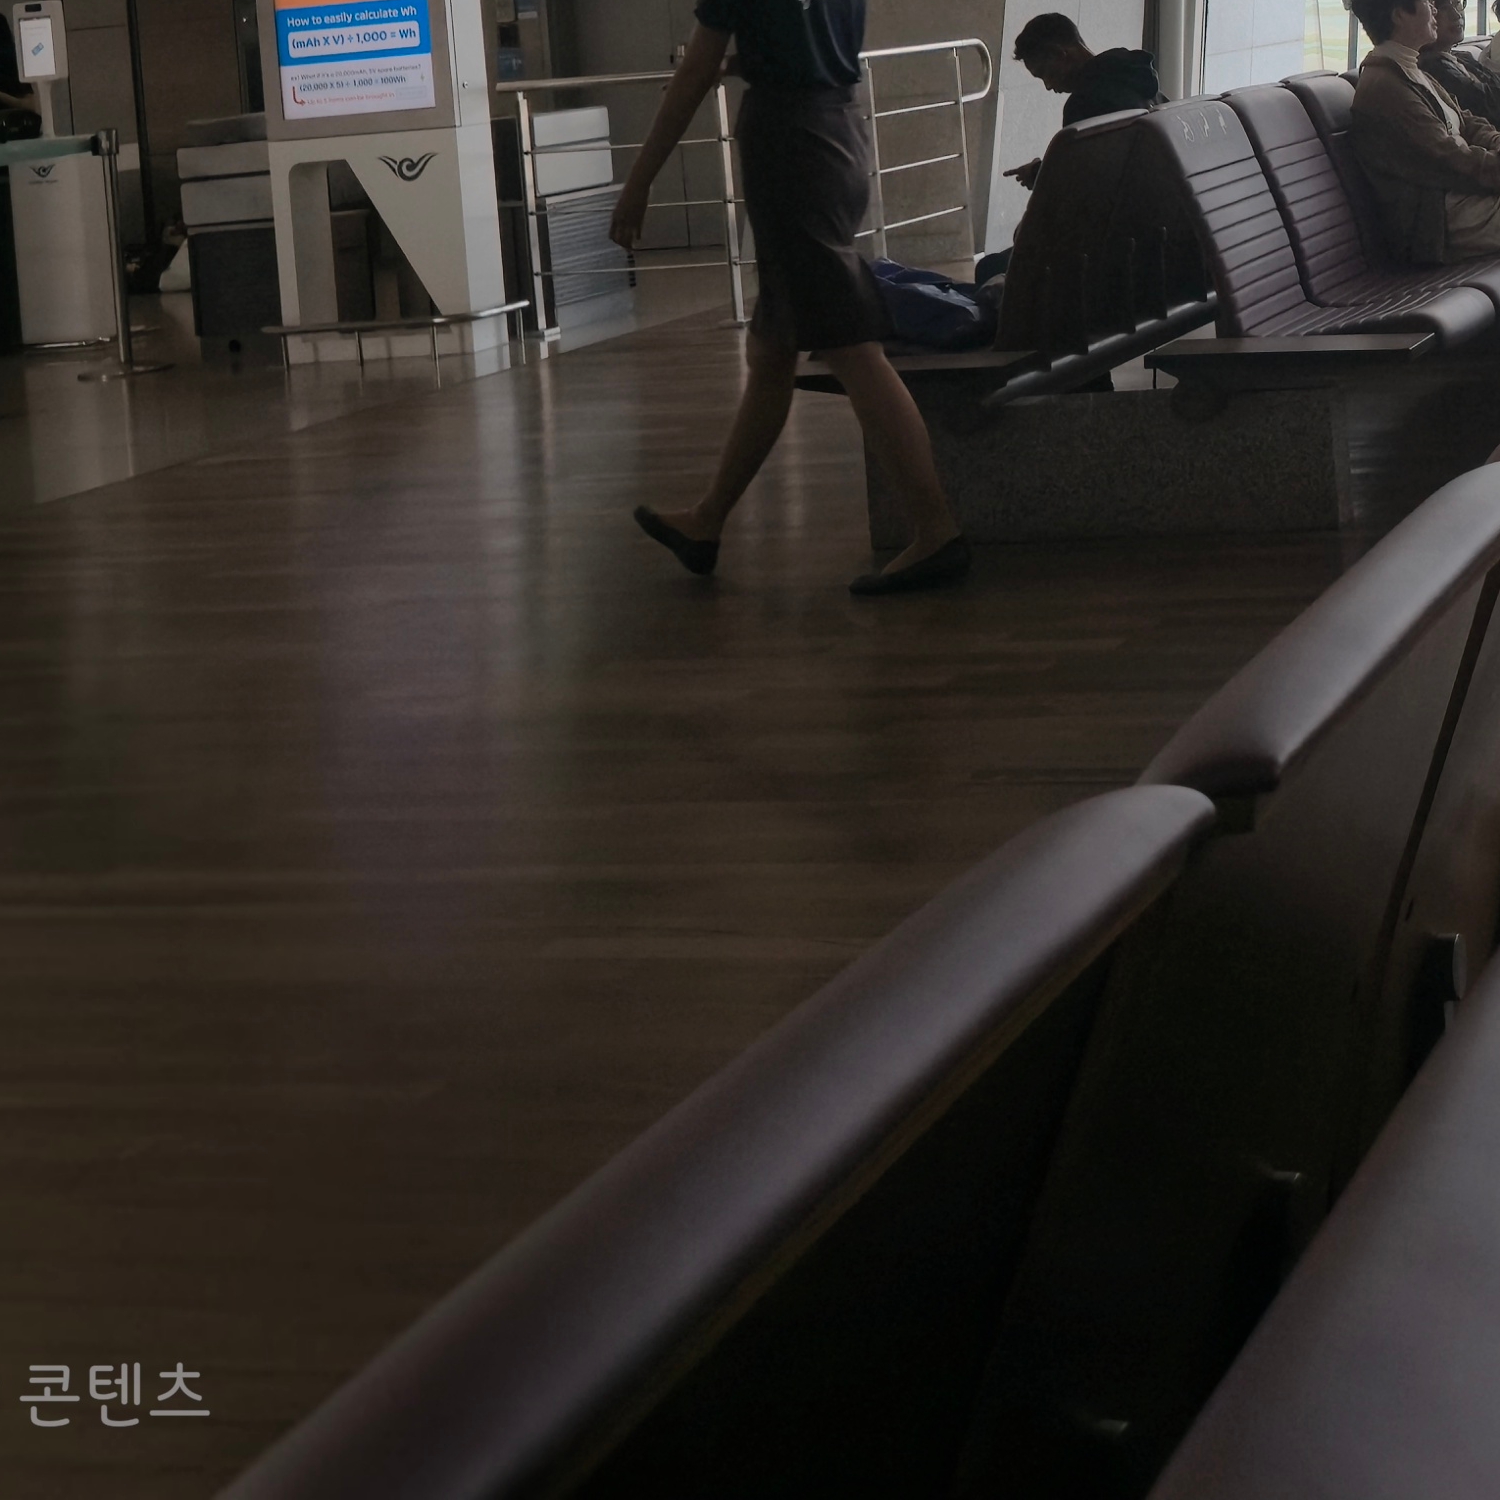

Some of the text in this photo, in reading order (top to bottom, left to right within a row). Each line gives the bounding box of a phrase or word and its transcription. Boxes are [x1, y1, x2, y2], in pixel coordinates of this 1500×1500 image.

[287, 5, 417, 28] How to easily calculate Wh
[292, 36, 321, 50] (mAh
[332, 34, 345, 46] V)
[355, 30, 388, 45] 1,000
[399, 28, 416, 40] Wh
